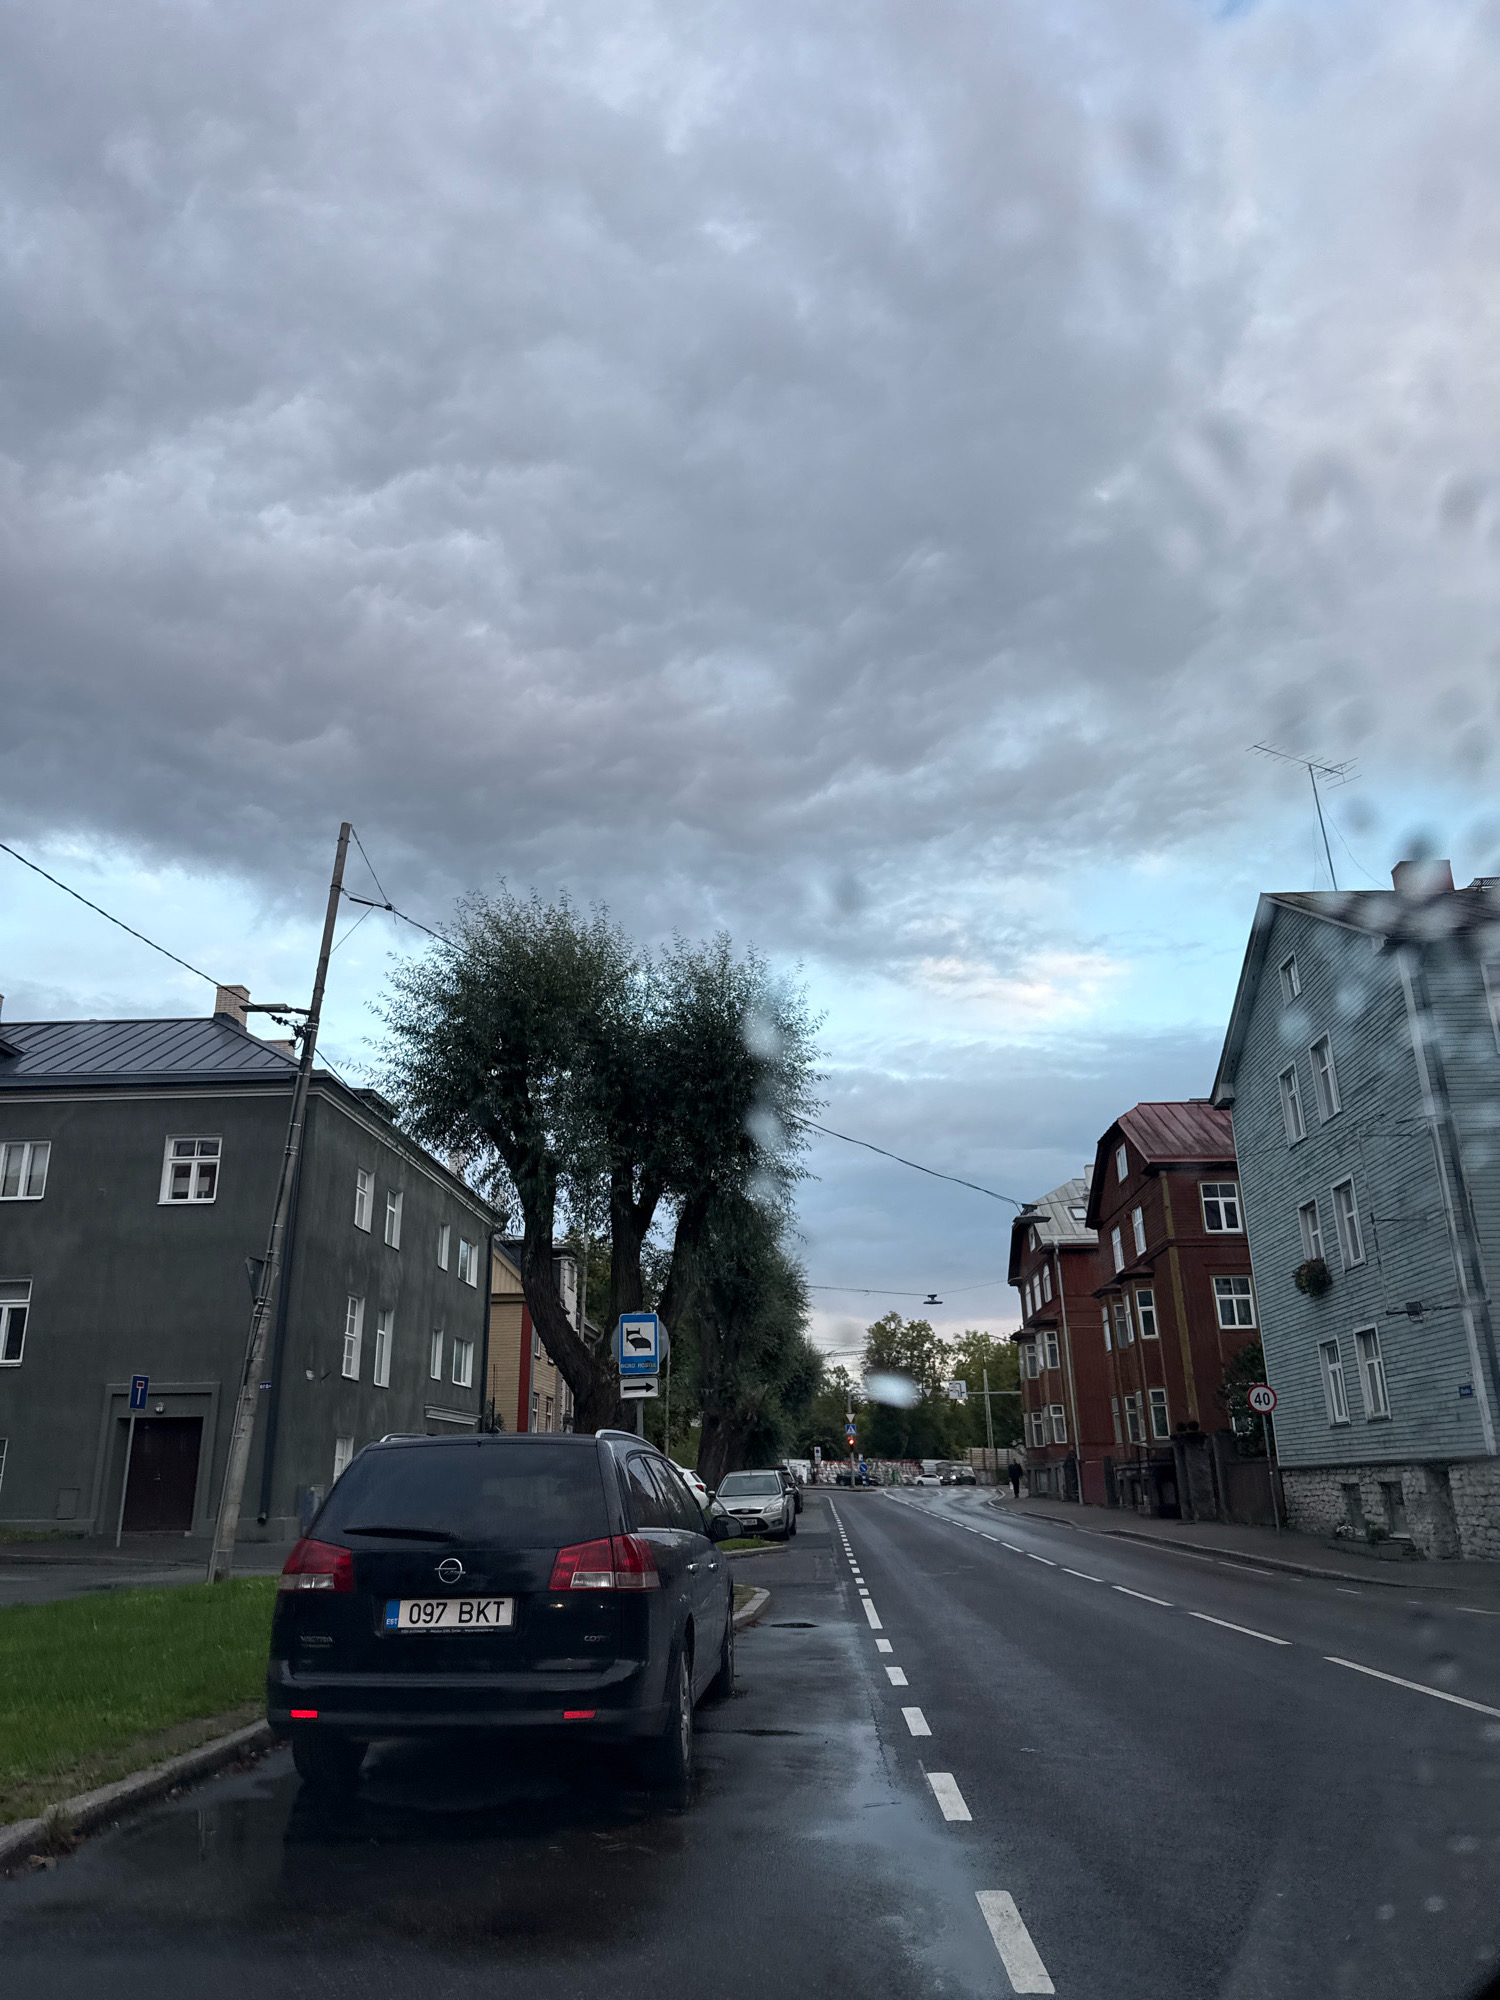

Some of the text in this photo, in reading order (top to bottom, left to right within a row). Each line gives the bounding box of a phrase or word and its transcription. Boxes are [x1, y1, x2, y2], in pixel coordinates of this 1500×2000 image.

[1254, 1392, 1270, 1405] 40
[408, 1601, 505, 1624] 097 BKT
